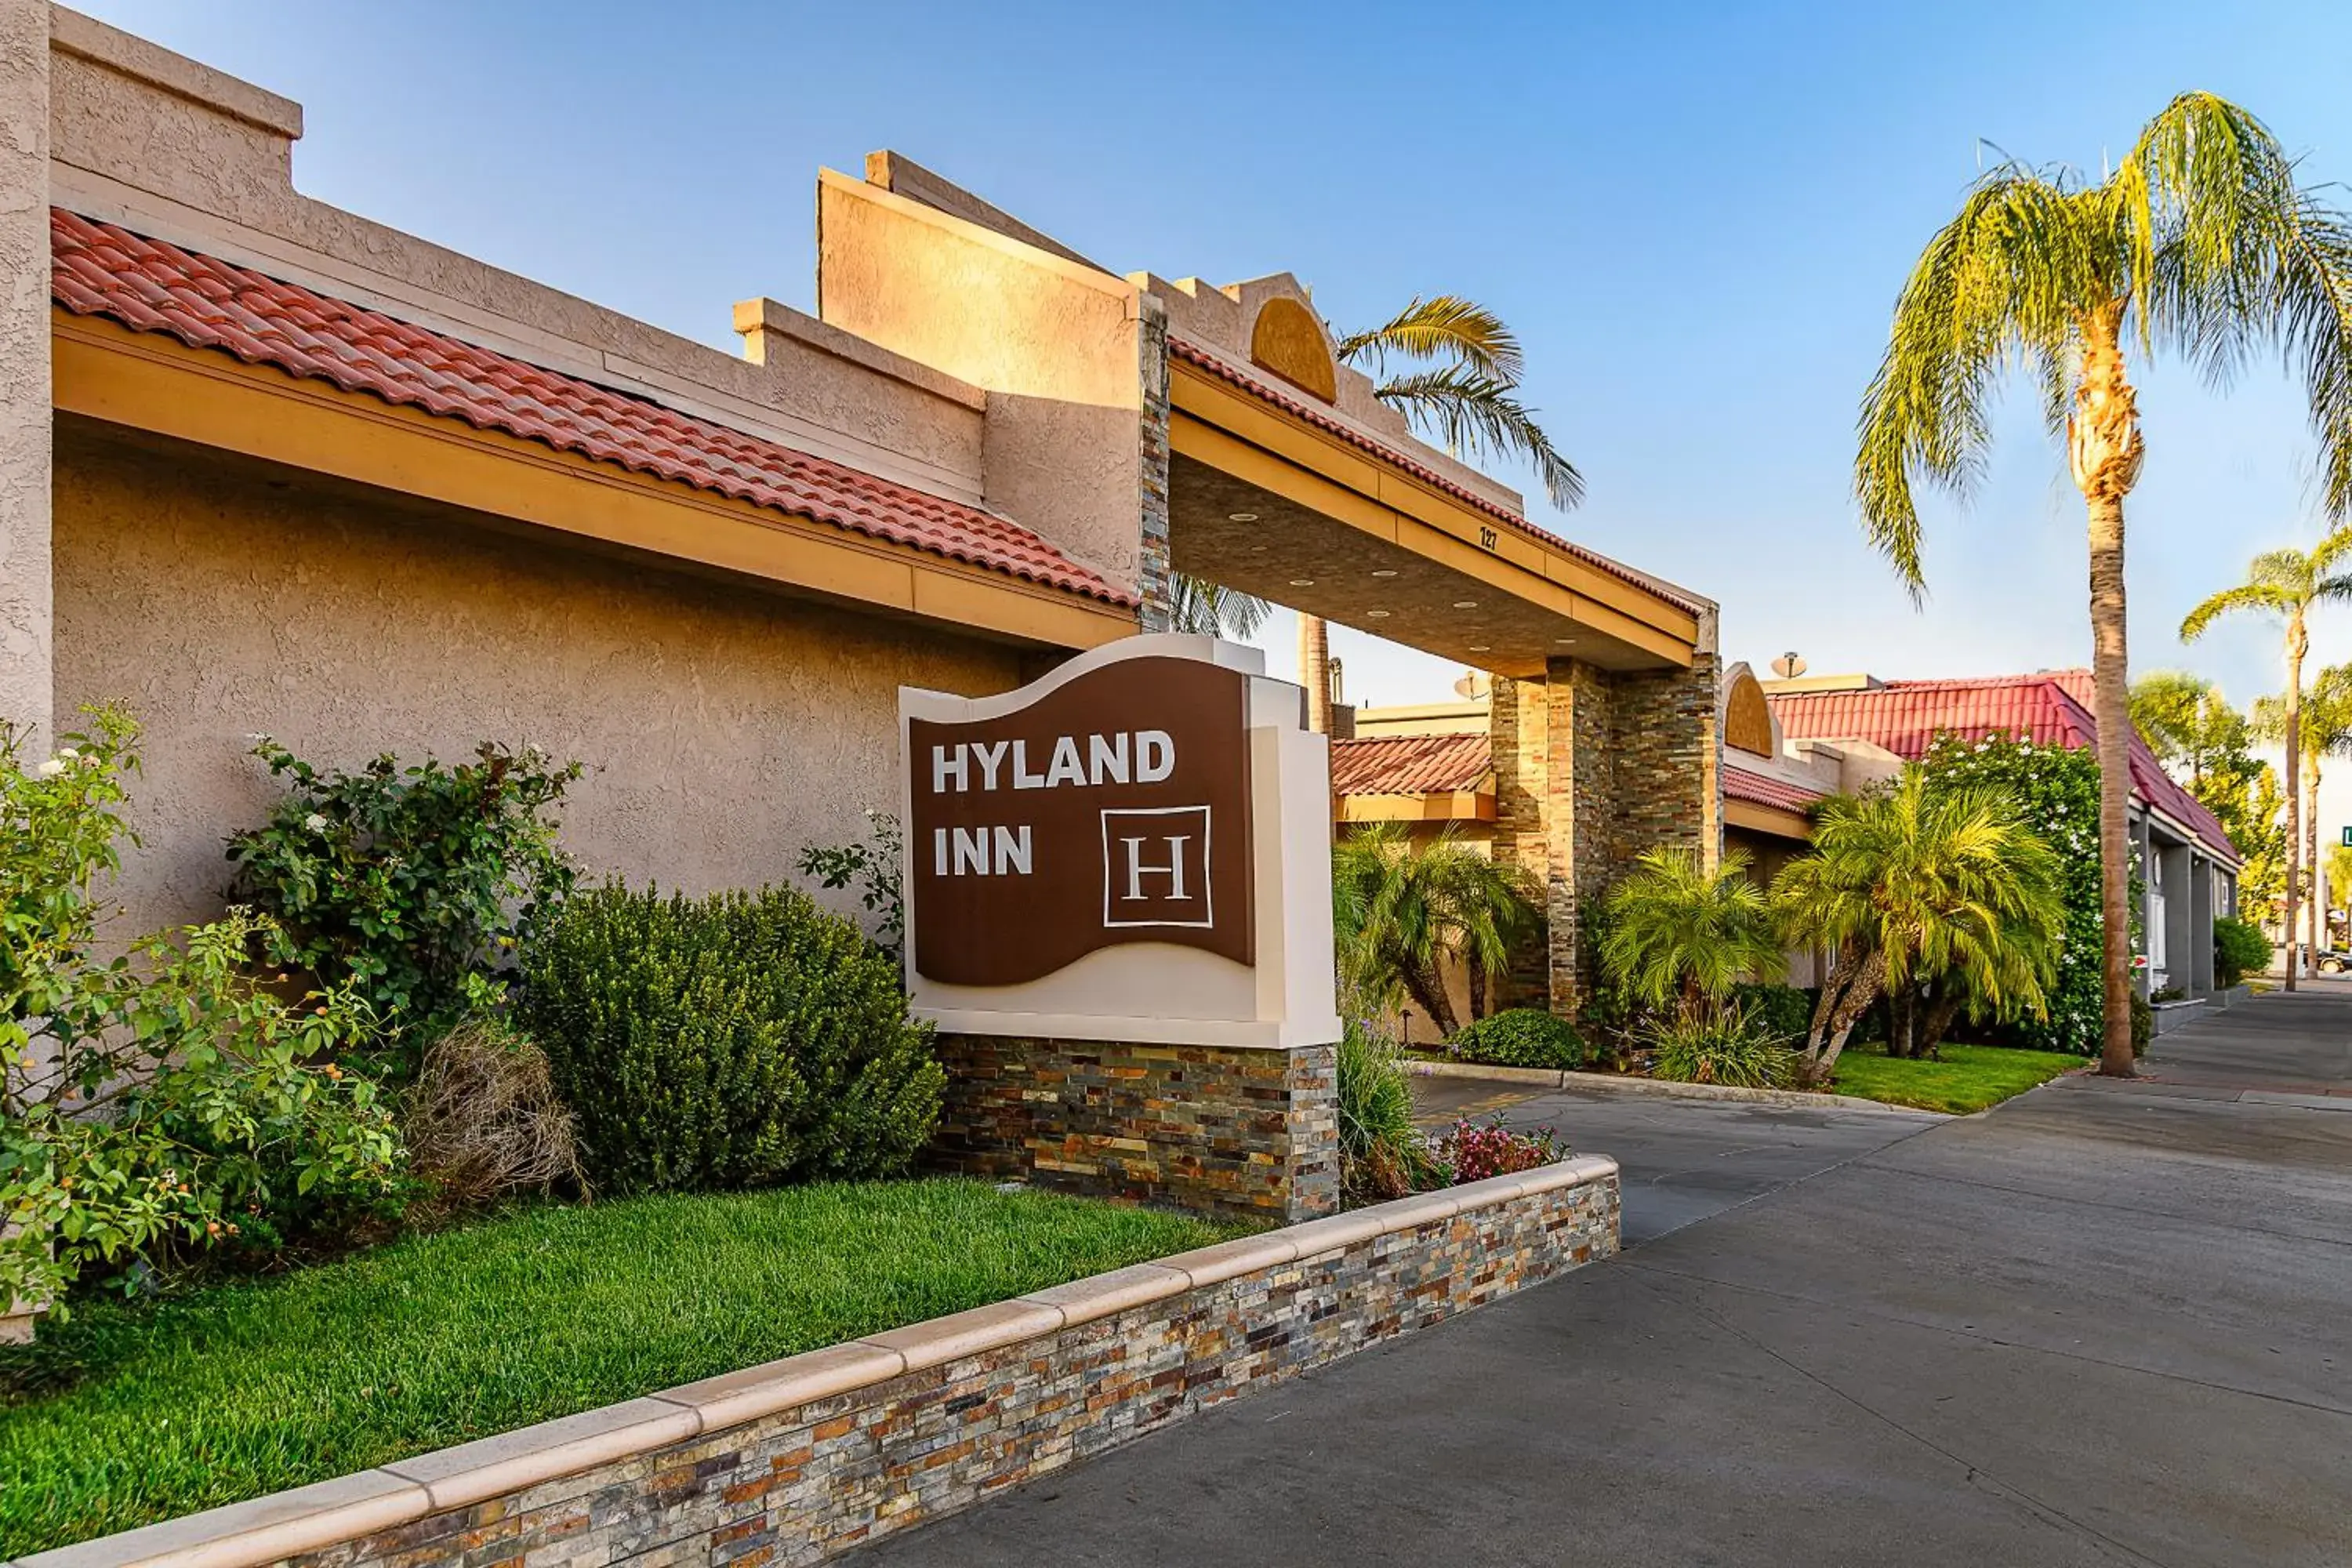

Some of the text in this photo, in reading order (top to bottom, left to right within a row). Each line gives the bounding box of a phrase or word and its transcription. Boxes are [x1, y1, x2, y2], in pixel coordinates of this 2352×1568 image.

[932, 730, 1175, 793] HYLAND
[935, 825, 1033, 876] INN
[1120, 835, 1192, 899] H
